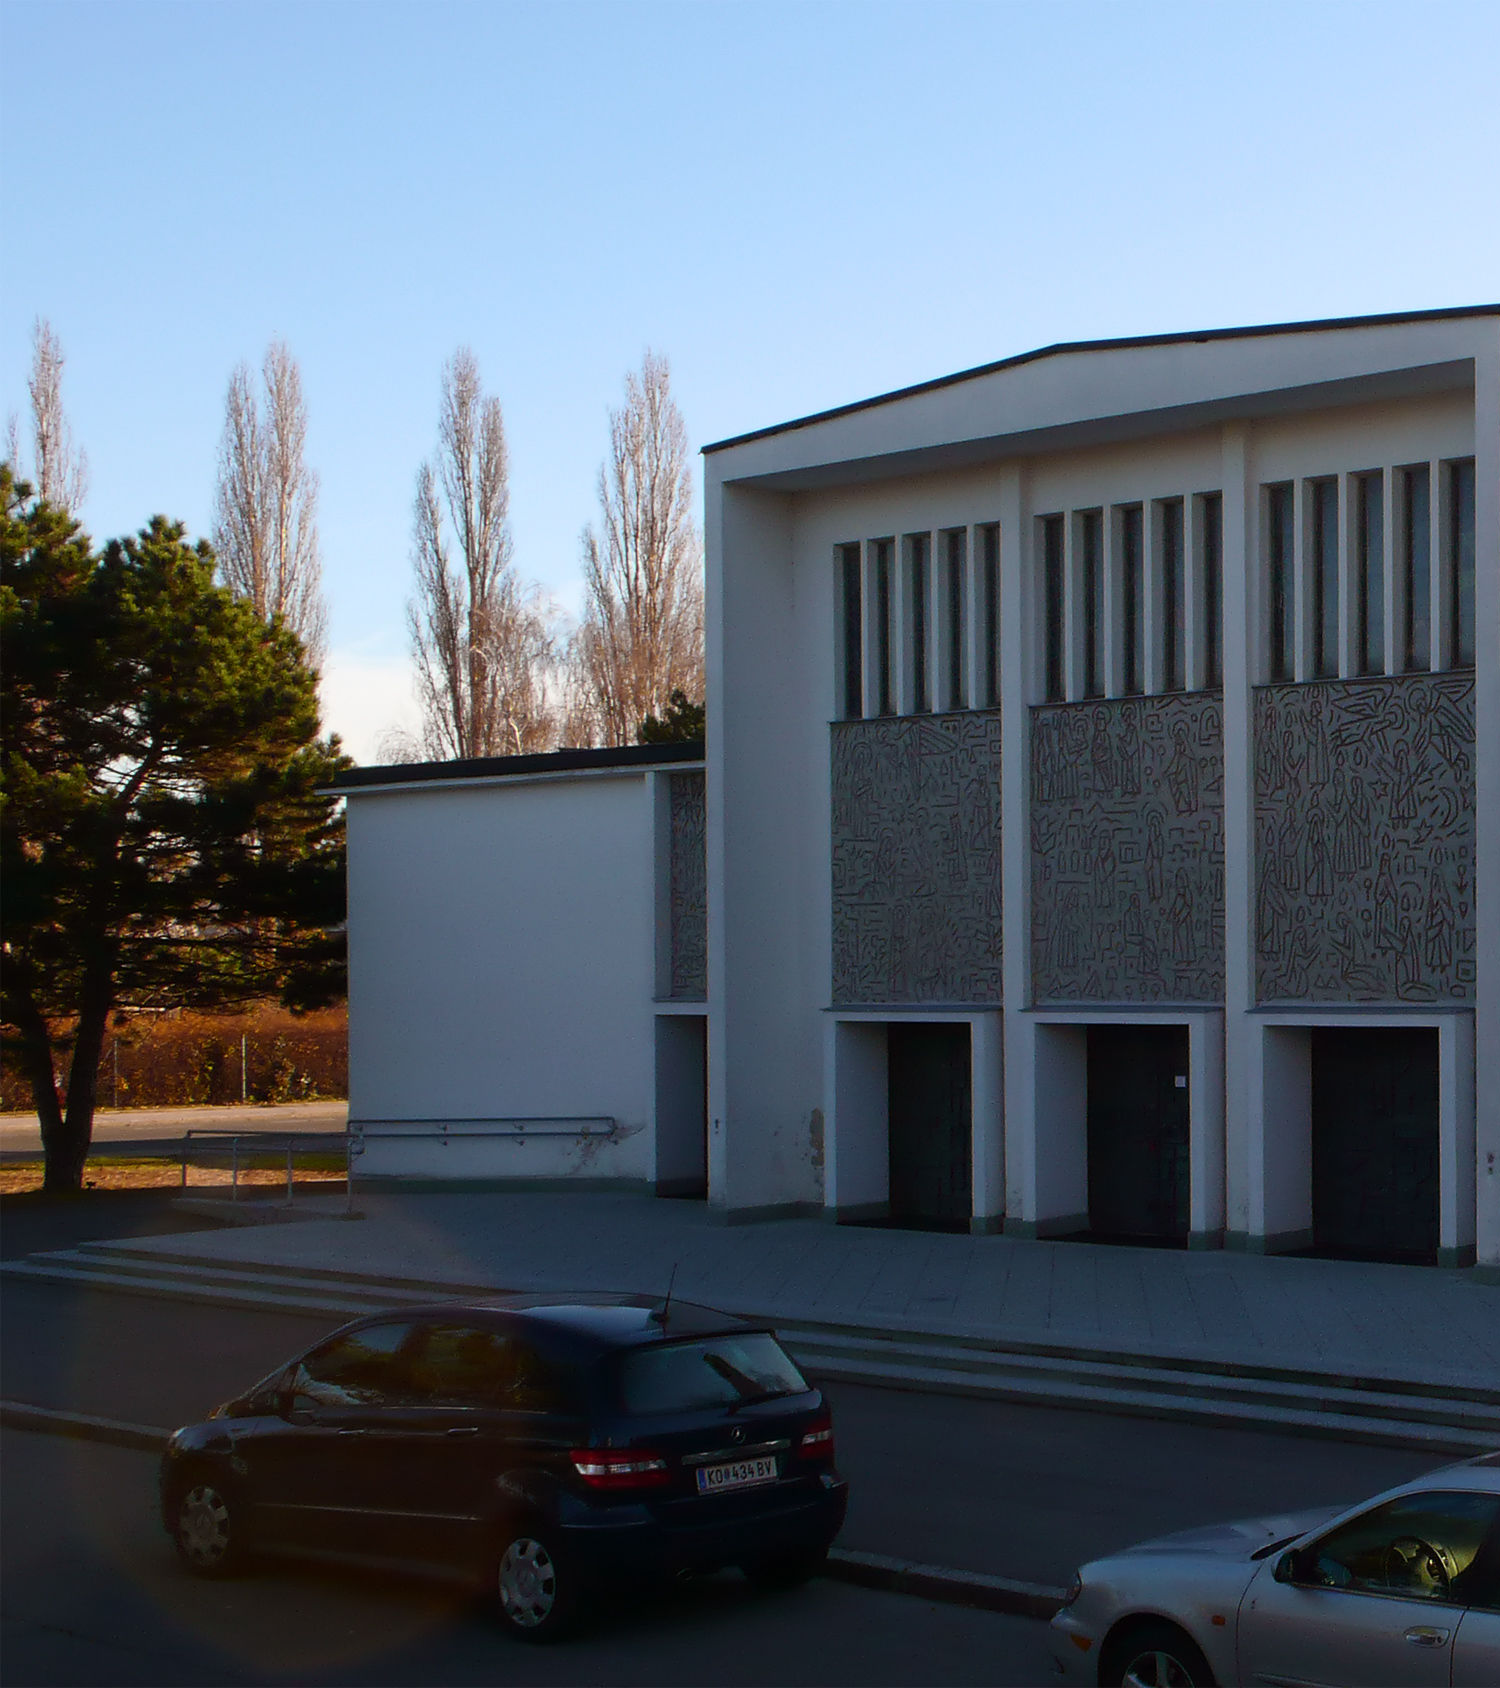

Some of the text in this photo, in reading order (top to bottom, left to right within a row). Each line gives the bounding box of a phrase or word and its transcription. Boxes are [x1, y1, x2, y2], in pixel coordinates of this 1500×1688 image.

[707, 1461, 771, 1485] KO 434 BV
